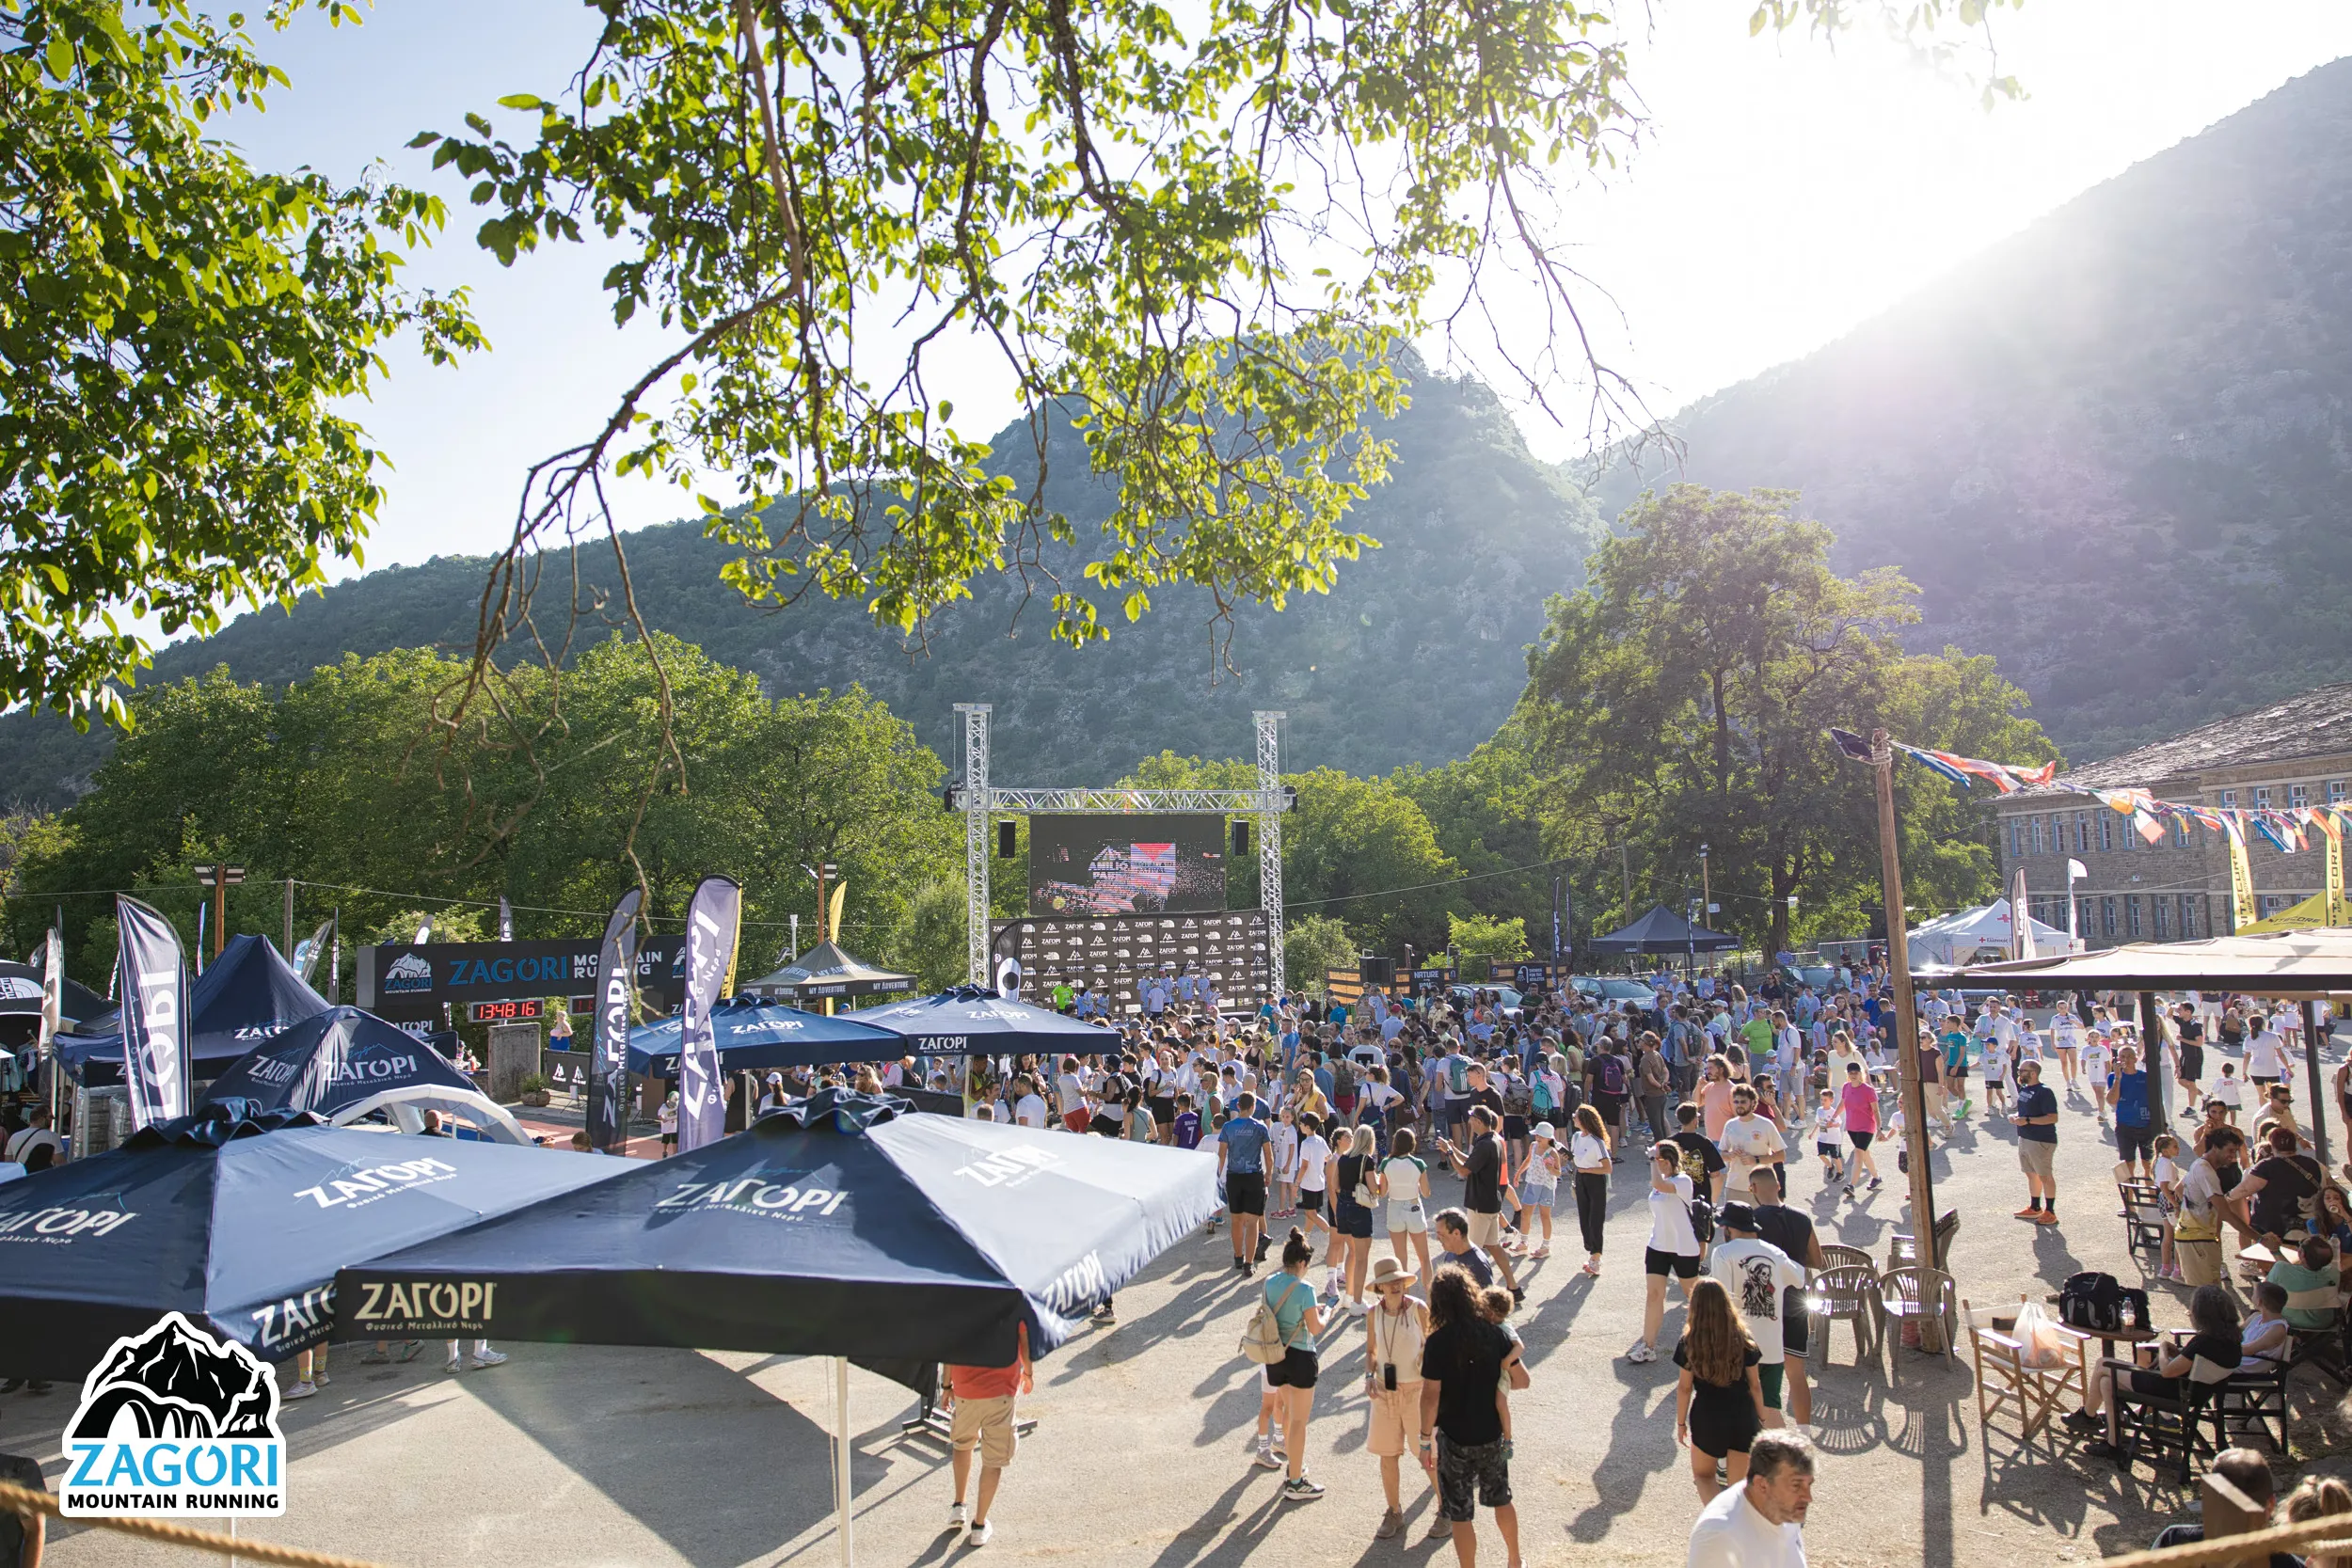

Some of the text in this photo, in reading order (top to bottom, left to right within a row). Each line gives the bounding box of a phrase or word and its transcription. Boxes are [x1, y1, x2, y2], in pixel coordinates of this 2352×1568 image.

[448, 957, 567, 985] ZAGORI
[384, 977, 432, 990] ZAGORI
[818, 985, 846, 994] ADVENTURE
[882, 981, 909, 990] ADVENTURE
[730, 1021, 804, 1034] ΖΑΓΟΡΙ
[603, 968, 628, 1128] ΖΑΓΟΡΙ
[918, 1036, 967, 1050] ΖΑΓΟΡΙ
[247, 1055, 299, 1082] ΖΑΓΟΡΙ
[322, 1055, 418, 1081] ΖΑΓΟΡΙ
[1188, 1126, 1195, 1144] 7
[294, 1157, 457, 1208] ΖΑΓΟΡΙ
[655, 1179, 850, 1216] ΖΑΓΟΡΙ
[706, 1204, 767, 1216] Μεταλλικό
[771, 1211, 804, 1222] Νερό
[354, 1283, 493, 1320] ΖΑΓΟΡΙ
[366, 1321, 483, 1331] Φυσικό Μεταλλικό Νερό
